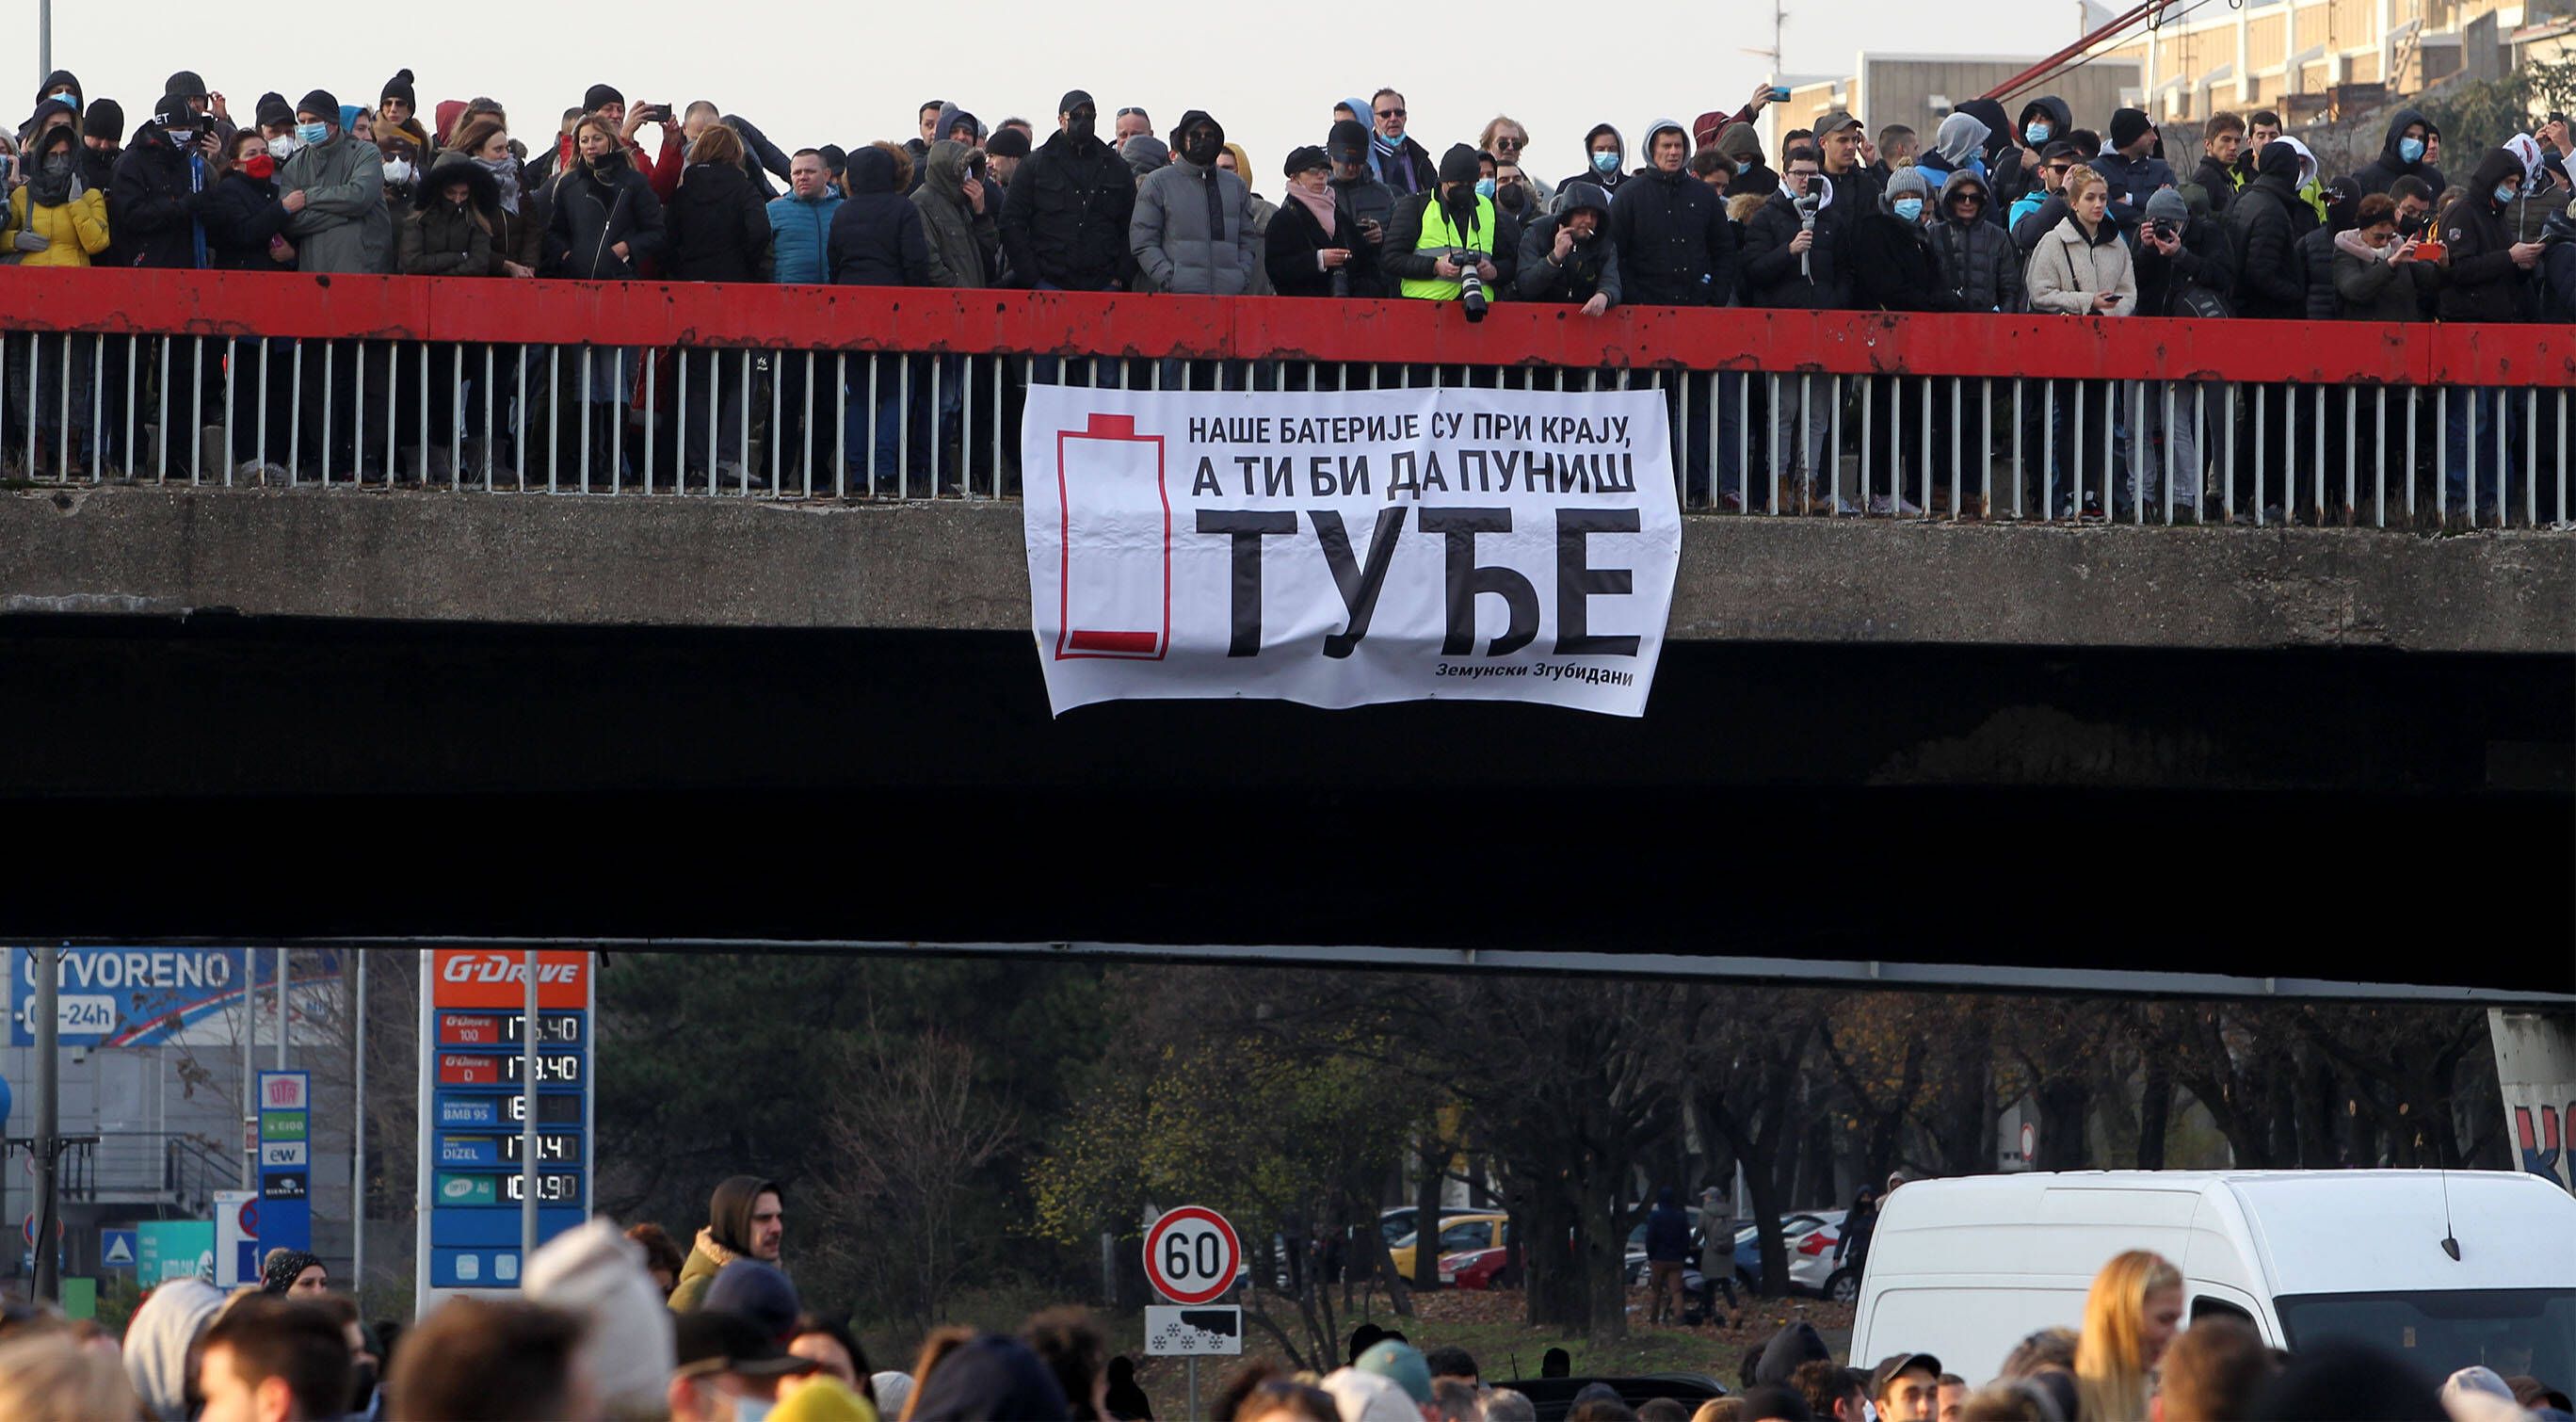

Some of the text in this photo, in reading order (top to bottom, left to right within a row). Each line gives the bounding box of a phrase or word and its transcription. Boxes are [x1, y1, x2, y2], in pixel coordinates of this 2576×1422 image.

[1189, 412, 1631, 448] НАШЕ БАТЕРИЈЕ СУ ПРИ КРАЈУ,
[1193, 450, 1637, 502] А ТИ БИ ДА ПУНИШ
[1195, 506, 1642, 658] ТУЂЕ
[1435, 662, 1634, 687] Земунски Згубидани
[30, 1004, 110, 1026] -24h
[459, 1029, 479, 1042] 100
[473, 1109, 489, 1121] 95
[443, 1146, 478, 1160] DIZEL
[1166, 1232, 1220, 1281] 60
